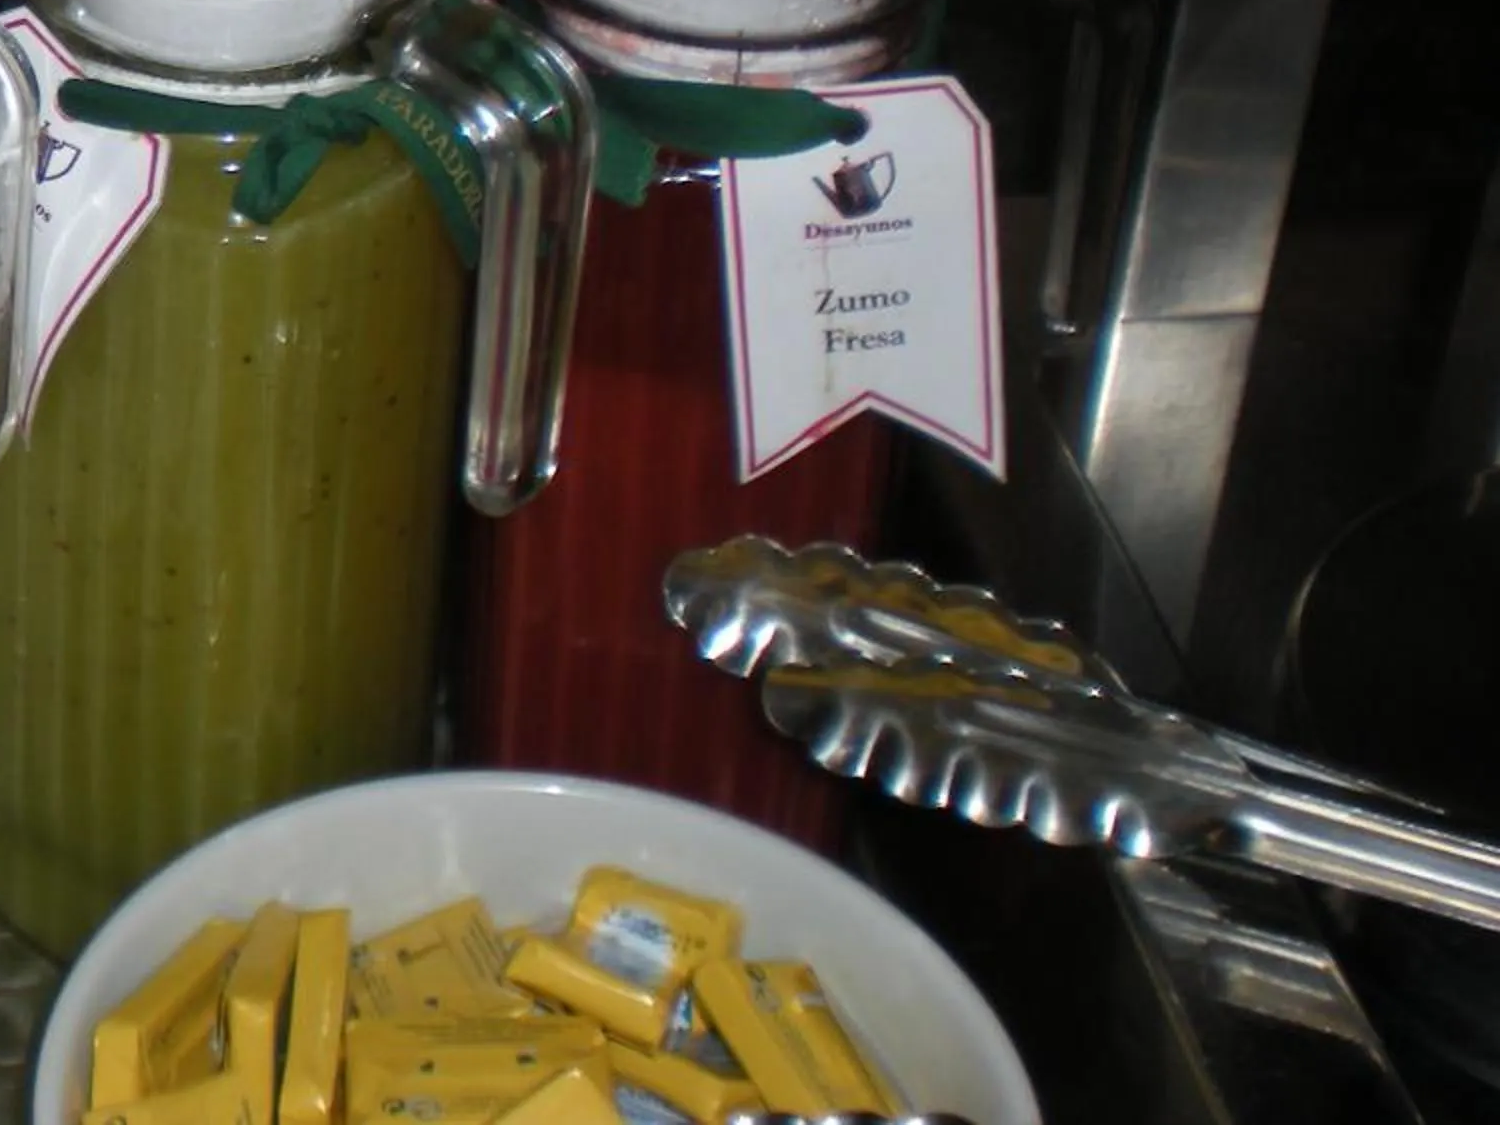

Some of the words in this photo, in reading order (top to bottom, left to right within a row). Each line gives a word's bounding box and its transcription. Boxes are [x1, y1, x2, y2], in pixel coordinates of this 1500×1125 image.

[804, 217, 913, 240] Desayunos
[814, 288, 911, 316] Zumo
[825, 328, 906, 354] Fresa
